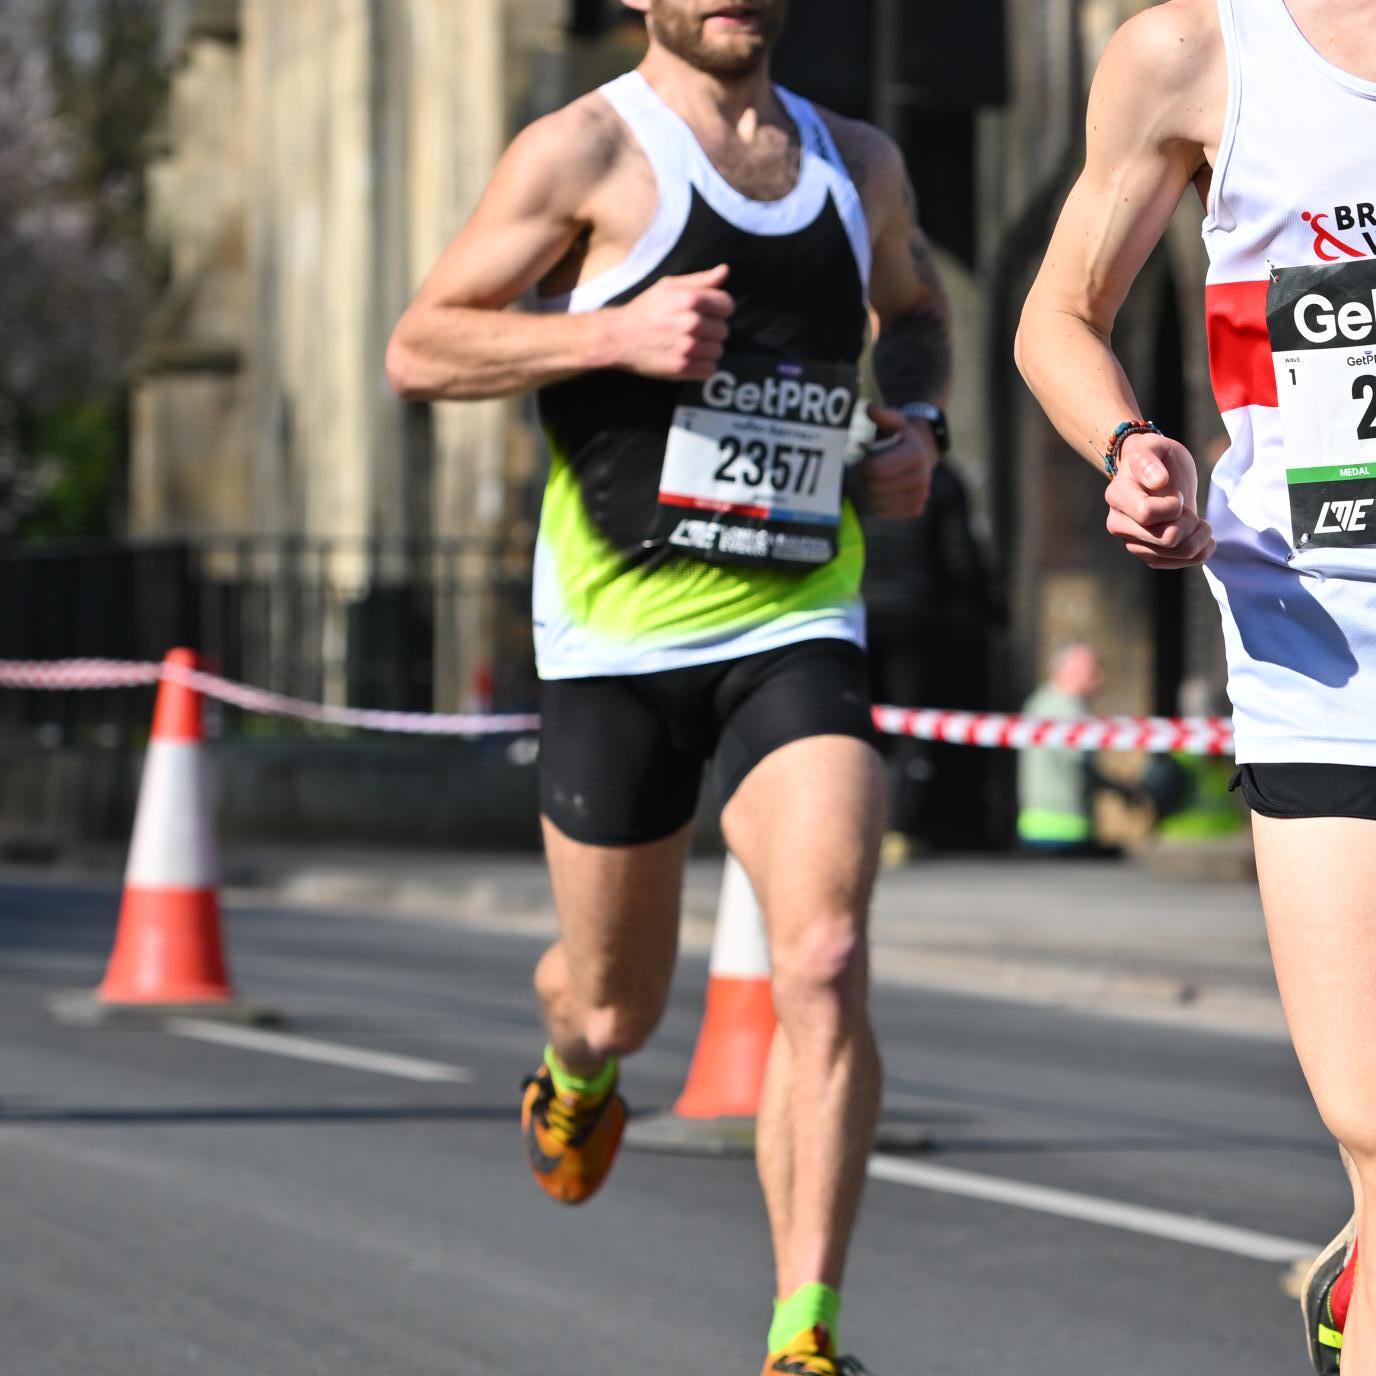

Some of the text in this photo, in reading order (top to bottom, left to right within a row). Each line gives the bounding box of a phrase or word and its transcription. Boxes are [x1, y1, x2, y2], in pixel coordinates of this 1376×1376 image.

[1284, 356, 1301, 364] WAVE
[1288, 368, 1297, 386] 1
[702, 370, 851, 425] GetPRO
[1339, 466, 1371, 477] MEDAL
